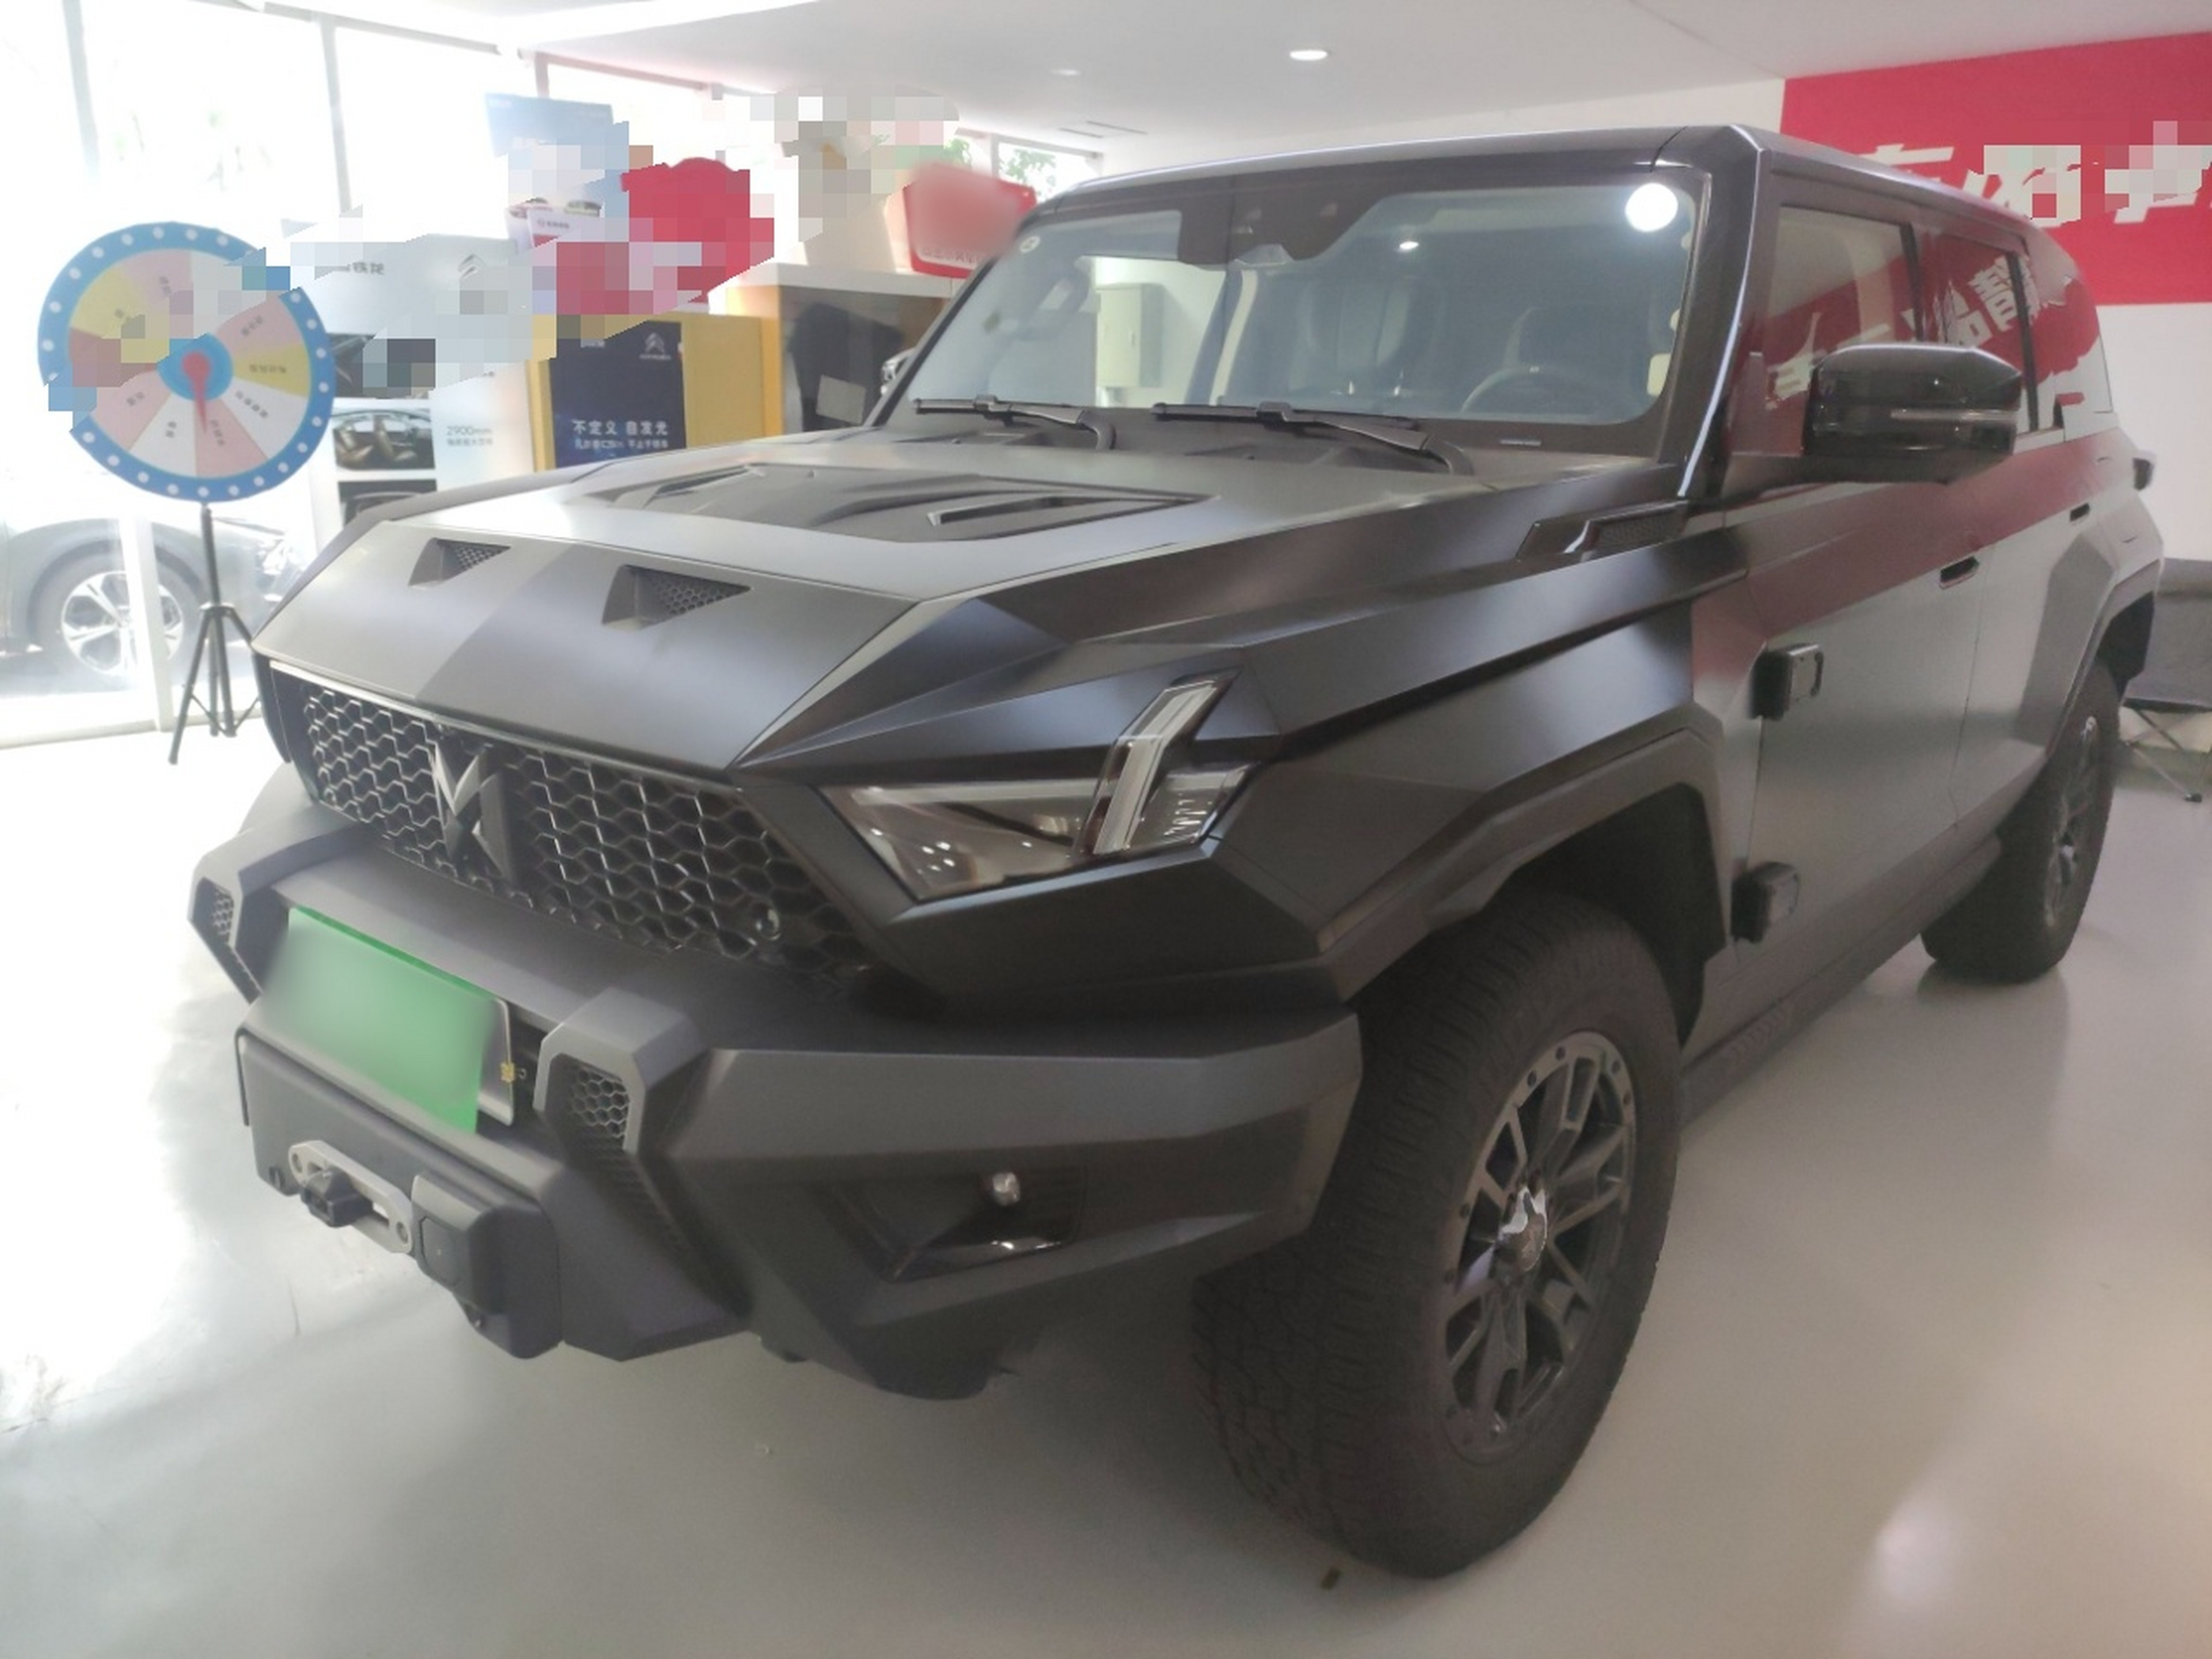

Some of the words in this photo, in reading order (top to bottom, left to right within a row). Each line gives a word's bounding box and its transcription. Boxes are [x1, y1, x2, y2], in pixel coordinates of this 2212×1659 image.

[572, 419, 616, 435] 不定义
[626, 420, 668, 435] 自发光
